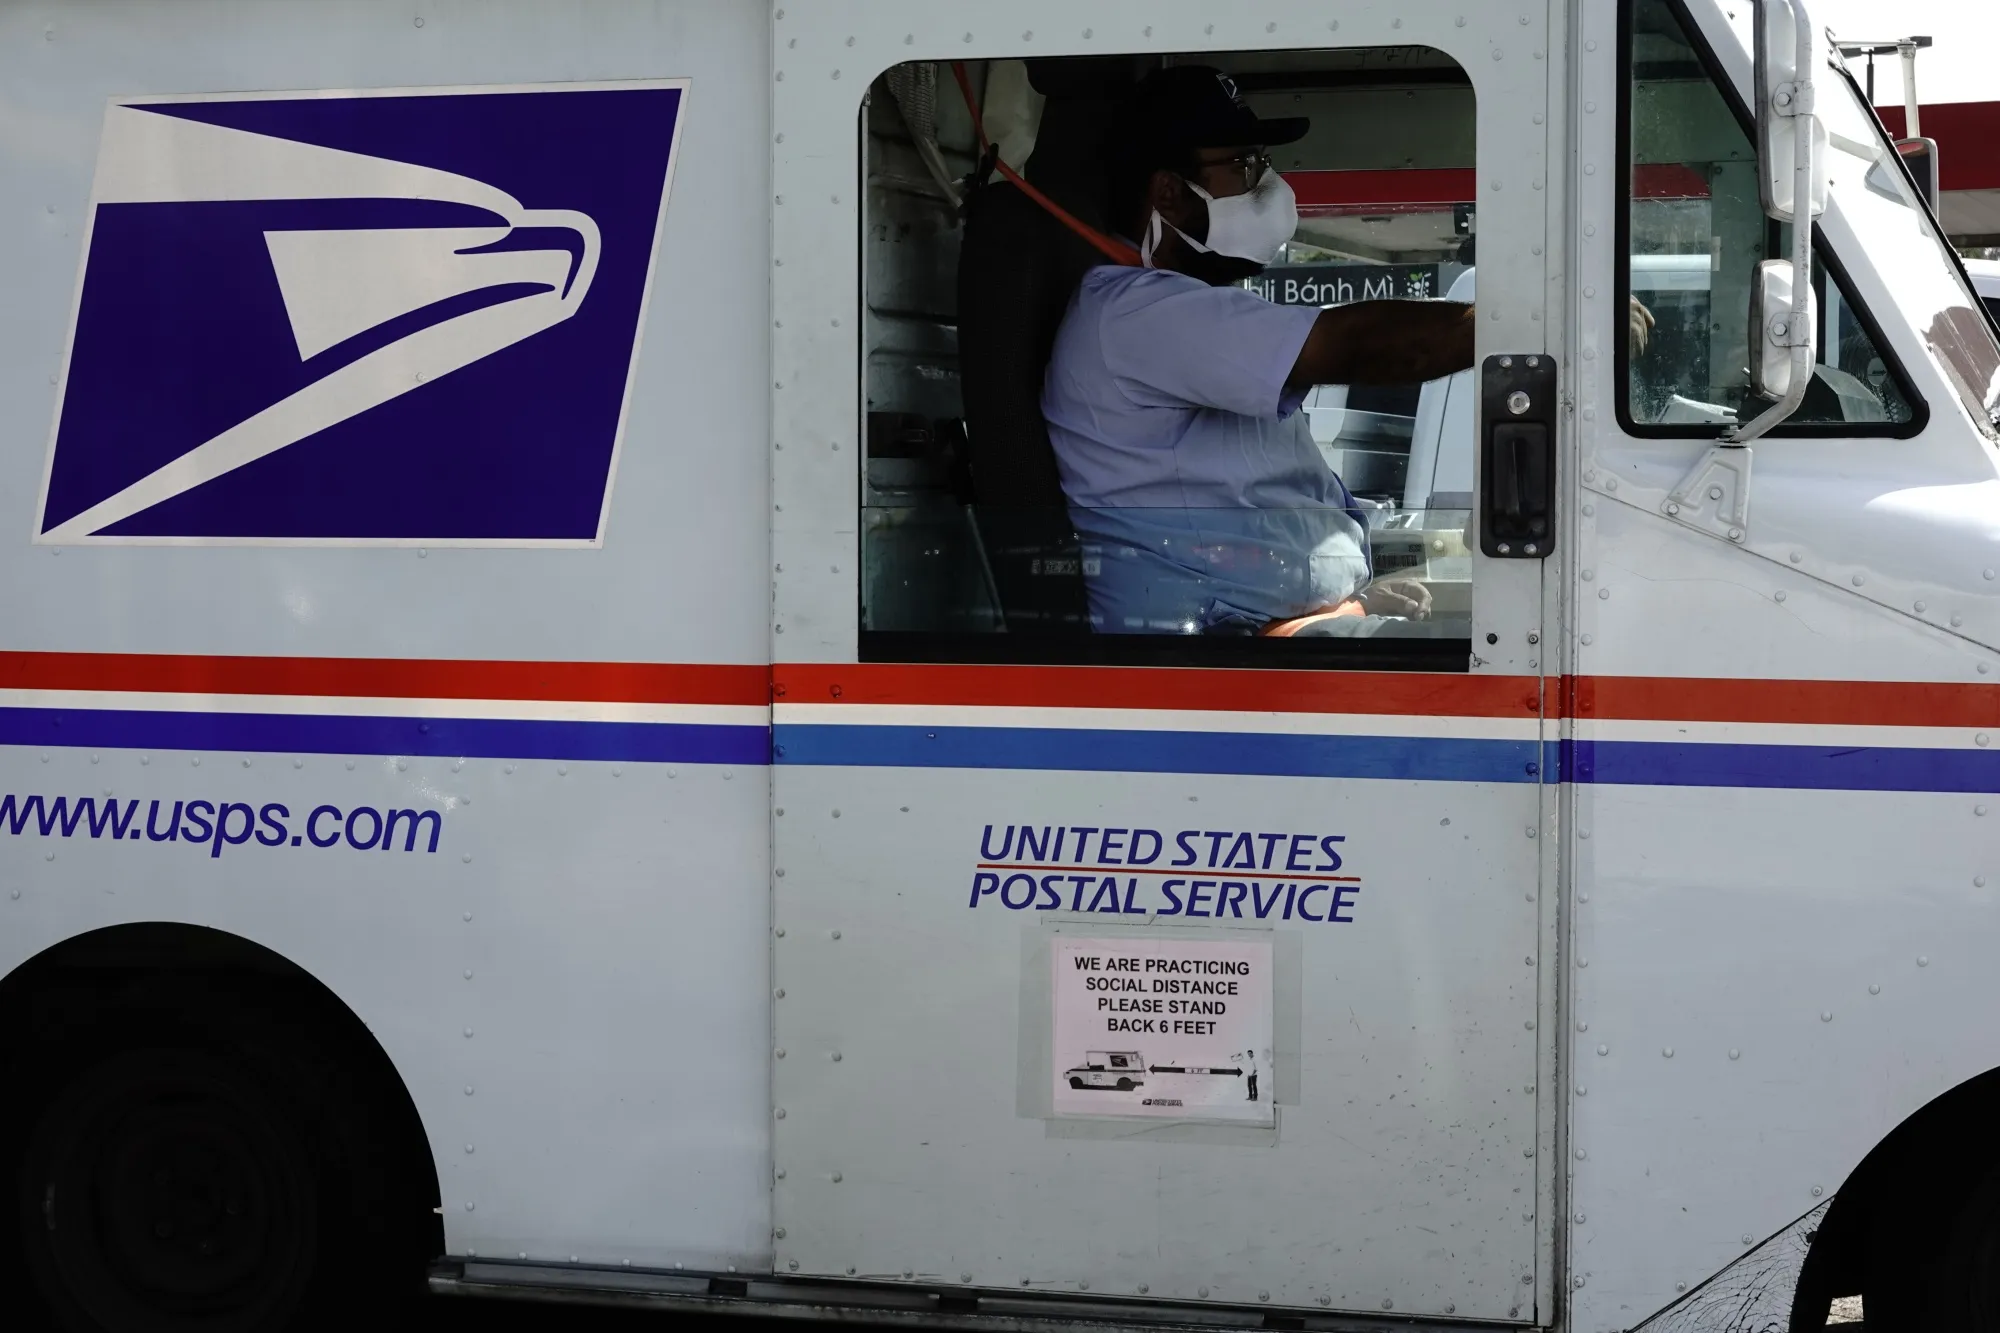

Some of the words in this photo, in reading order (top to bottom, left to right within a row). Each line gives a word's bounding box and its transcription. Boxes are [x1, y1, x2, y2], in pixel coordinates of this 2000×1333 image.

[1284, 276, 1354, 303] Bánh
[0, 794, 442, 858] www.usps.com
[980, 824, 1163, 865] UNITED
[1171, 830, 1346, 872] STATES
[969, 872, 1148, 915] POSTAL
[1156, 879, 1361, 923] SERVICE
[1074, 957, 1101, 970] WE
[1105, 958, 1140, 972] ARE
[1145, 959, 1250, 976] PRACTICING
[1086, 977, 1148, 993] SOCIAL
[1153, 979, 1239, 996] DISTANCE
[1098, 997, 1163, 1013] PLEASE
[1168, 1000, 1226, 1015] STAND
[1107, 1018, 1155, 1033] BACK
[1159, 1020, 1169, 1033] 6
[1174, 1020, 1217, 1035] FEET
